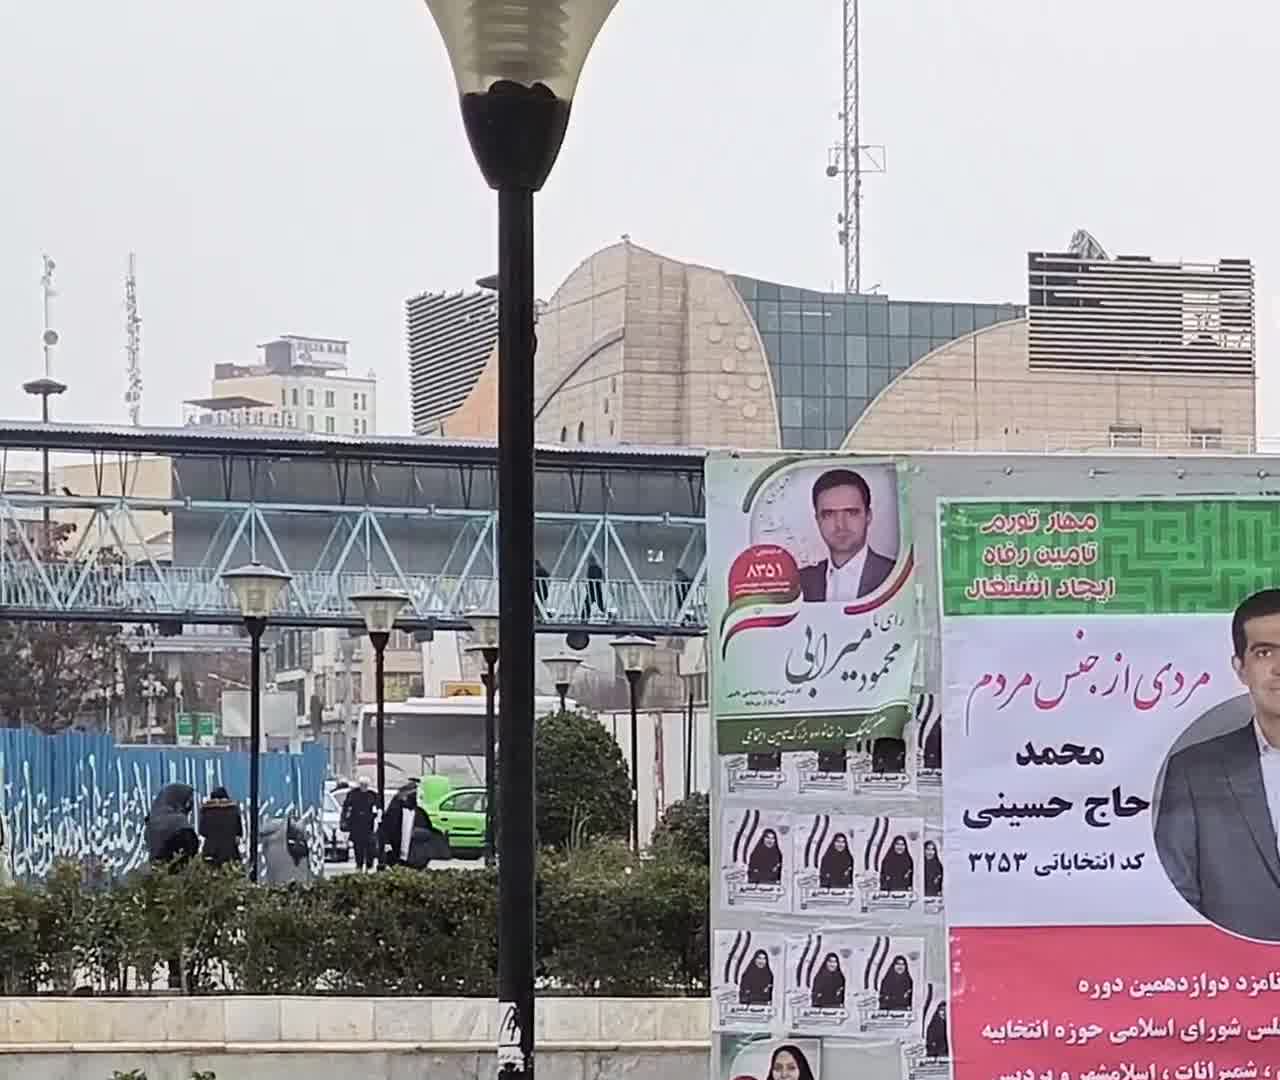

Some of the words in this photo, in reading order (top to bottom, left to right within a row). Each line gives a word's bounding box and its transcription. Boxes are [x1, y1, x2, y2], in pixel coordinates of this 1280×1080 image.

[980, 510, 1038, 534] تورم
[1044, 512, 1097, 534] مهار
[983, 542, 1027, 565] رفاه
[1036, 543, 1097, 567] تامین
[965, 573, 1050, 600] اشتغال
[1056, 577, 1116, 603] ایجاد
[1034, 629, 1099, 710] جنس
[1102, 652, 1130, 697] از
[1134, 663, 1210, 710] مردی
[965, 673, 1032, 736] مردم
[1016, 741, 1104, 766] محمد
[963, 792, 1073, 829] حسینی
[1084, 785, 1150, 827] حاج
[968, 852, 1027, 873] ۳۲۵۳
[1034, 851, 1115, 876] انتخاباتی
[1120, 852, 1145, 870] کد
[1078, 977, 1123, 1000] دوره
[1130, 974, 1229, 998] دوازدهمین
[981, 1018, 1050, 1047] انتخابیه
[1054, 1023, 1102, 1047] حوزه
[1109, 1018, 1176, 1045] اسلامی
[1180, 1017, 1241, 1045] شورای
